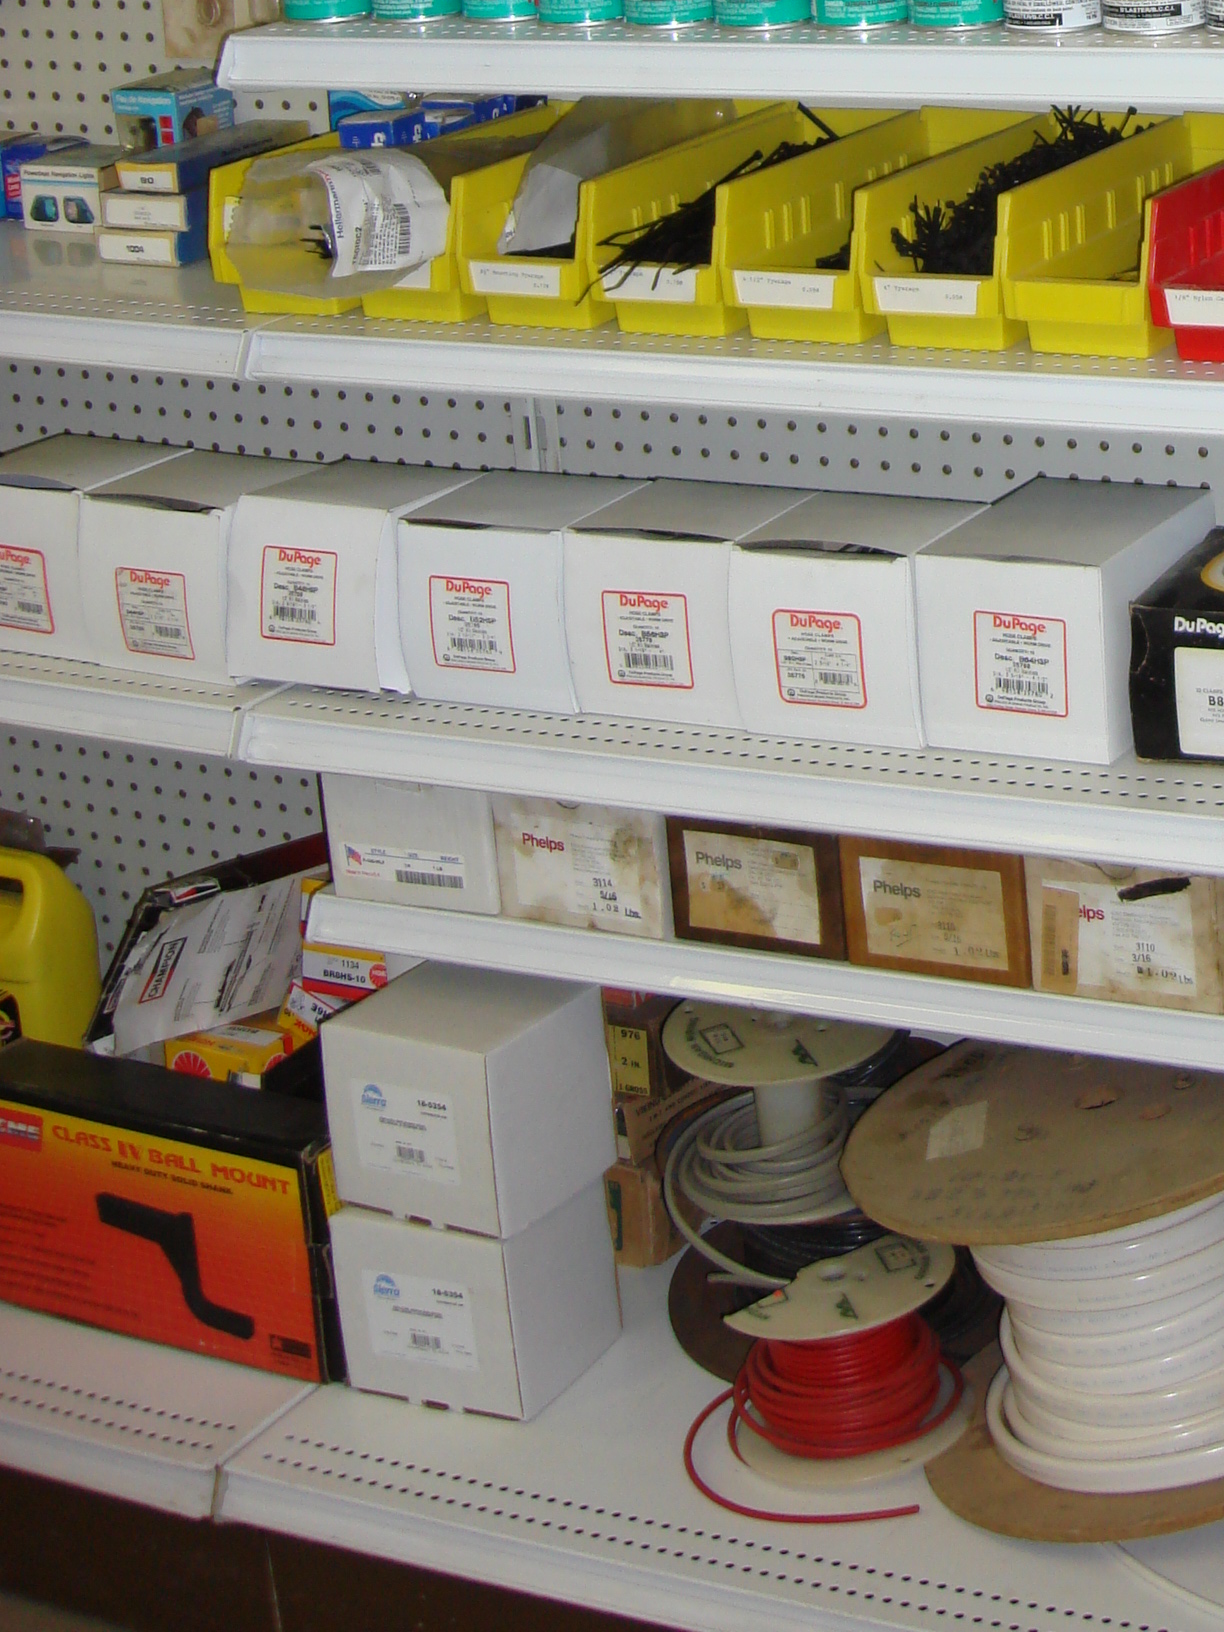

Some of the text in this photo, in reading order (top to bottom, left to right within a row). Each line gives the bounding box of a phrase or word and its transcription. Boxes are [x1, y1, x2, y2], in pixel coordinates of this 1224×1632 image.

[278, 549, 321, 567] DuPage
[130, 571, 170, 589] DuPage
[446, 580, 492, 598] DuPage
[619, 594, 668, 611] DuPage
[522, 832, 565, 853] Phelps
[696, 851, 742, 870] Phelps
[874, 879, 920, 898] Phelps
[1136, 942, 1155, 952] 3110
[341, 959, 359, 969] 1134
[1132, 954, 1151, 963] 3/16
[148, 941, 178, 998] CHAMPION
[620, 1029, 641, 1040] 976
[621, 1056, 628, 1067] 2
[52, 1125, 112, 1152] CLASS
[149, 1149, 202, 1174] BALL
[211, 1163, 290, 1194] MOUNT
